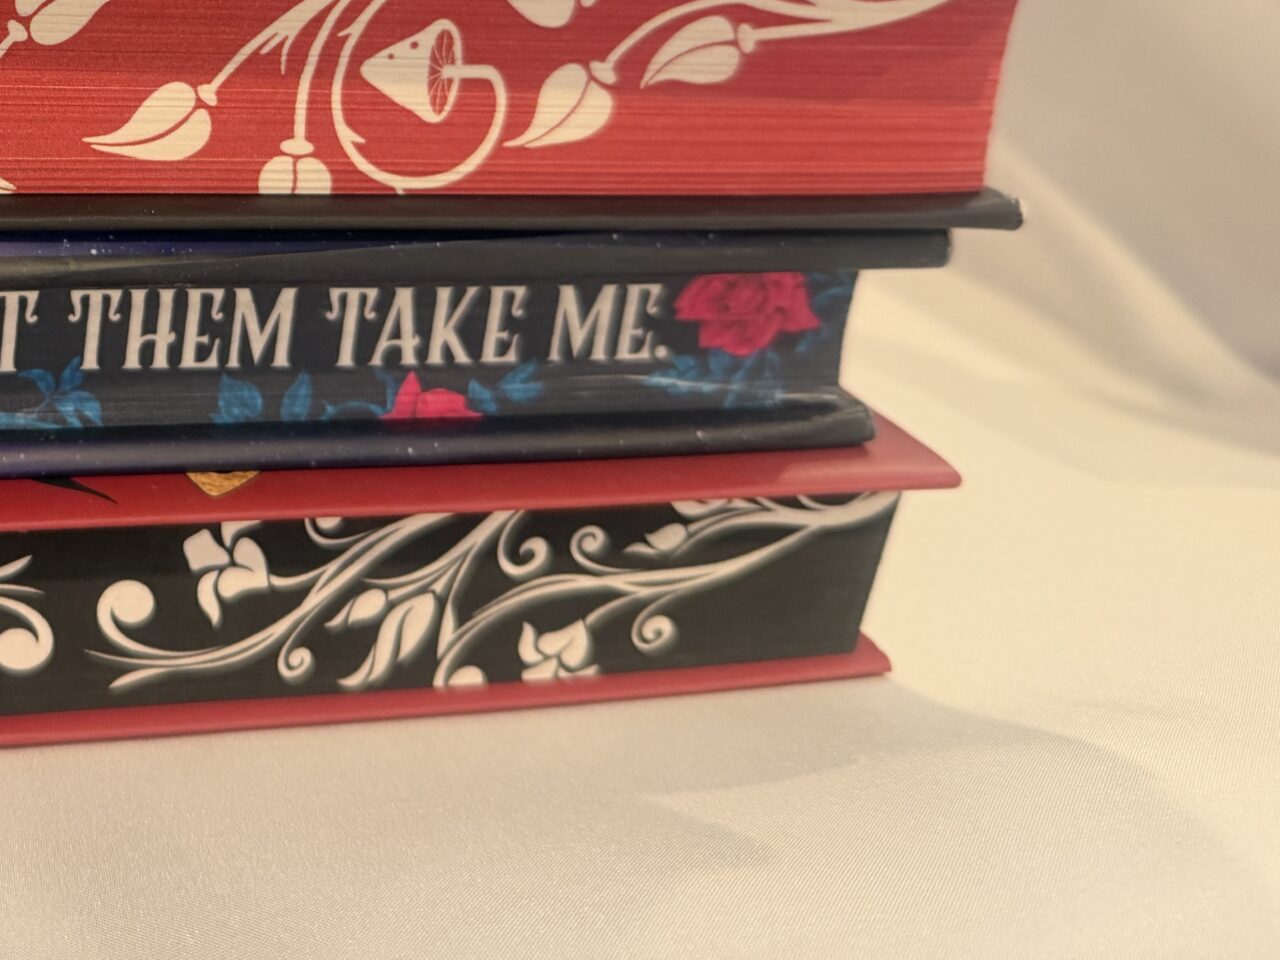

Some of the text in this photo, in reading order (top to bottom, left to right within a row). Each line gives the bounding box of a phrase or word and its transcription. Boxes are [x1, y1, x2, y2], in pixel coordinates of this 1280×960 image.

[66, 286, 295, 372] THEM
[324, 283, 530, 368] TAKE
[547, 280, 672, 363] ME.
